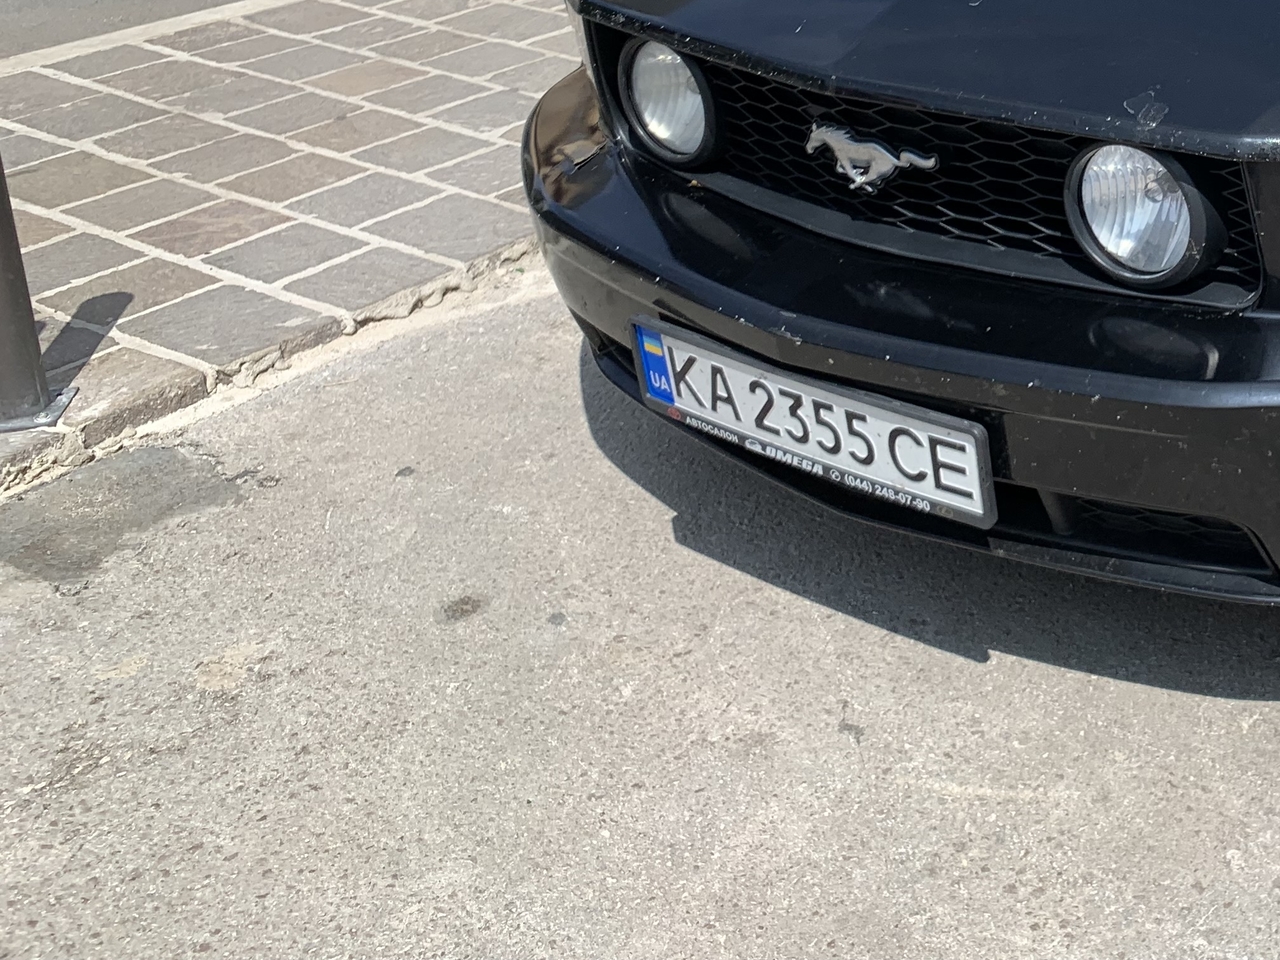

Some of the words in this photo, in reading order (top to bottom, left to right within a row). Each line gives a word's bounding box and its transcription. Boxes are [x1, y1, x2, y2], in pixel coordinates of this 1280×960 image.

[650, 369, 670, 393] UA
[666, 345, 744, 423] KA
[748, 378, 876, 466] 2355
[888, 425, 977, 502] CE
[685, 415, 739, 443] АВТОСАЛОН
[764, 445, 824, 476] OMEGA
[844, 472, 873, 494] (044)
[874, 483, 931, 513] 248-07-90
